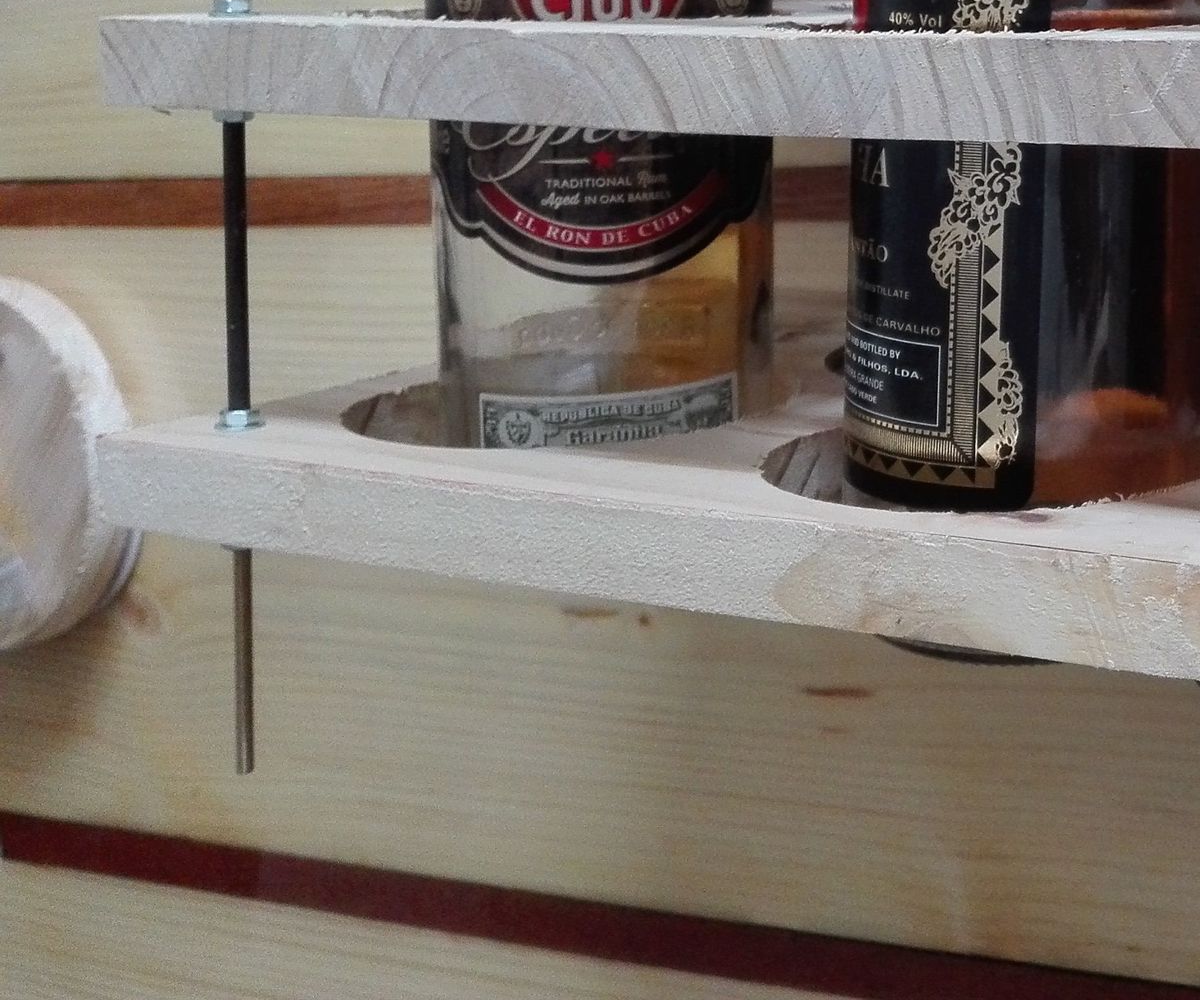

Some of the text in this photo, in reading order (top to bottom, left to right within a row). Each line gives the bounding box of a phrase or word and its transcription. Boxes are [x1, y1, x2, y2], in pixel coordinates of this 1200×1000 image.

[888, 11, 943, 29] 40% Vol
[544, 175, 632, 190] TRADITIONAL
[540, 191, 580, 210] Aged
[584, 195, 598, 206] IN
[599, 194, 625, 205] OAK
[513, 204, 693, 246] EL RON DE CUBA
[875, 316, 941, 337] CARVALHO
[859, 339, 888, 357] BOTTLED
[889, 348, 901, 360] BY
[857, 372, 885, 392] GRANDE
[894, 367, 923, 380] LDA.
